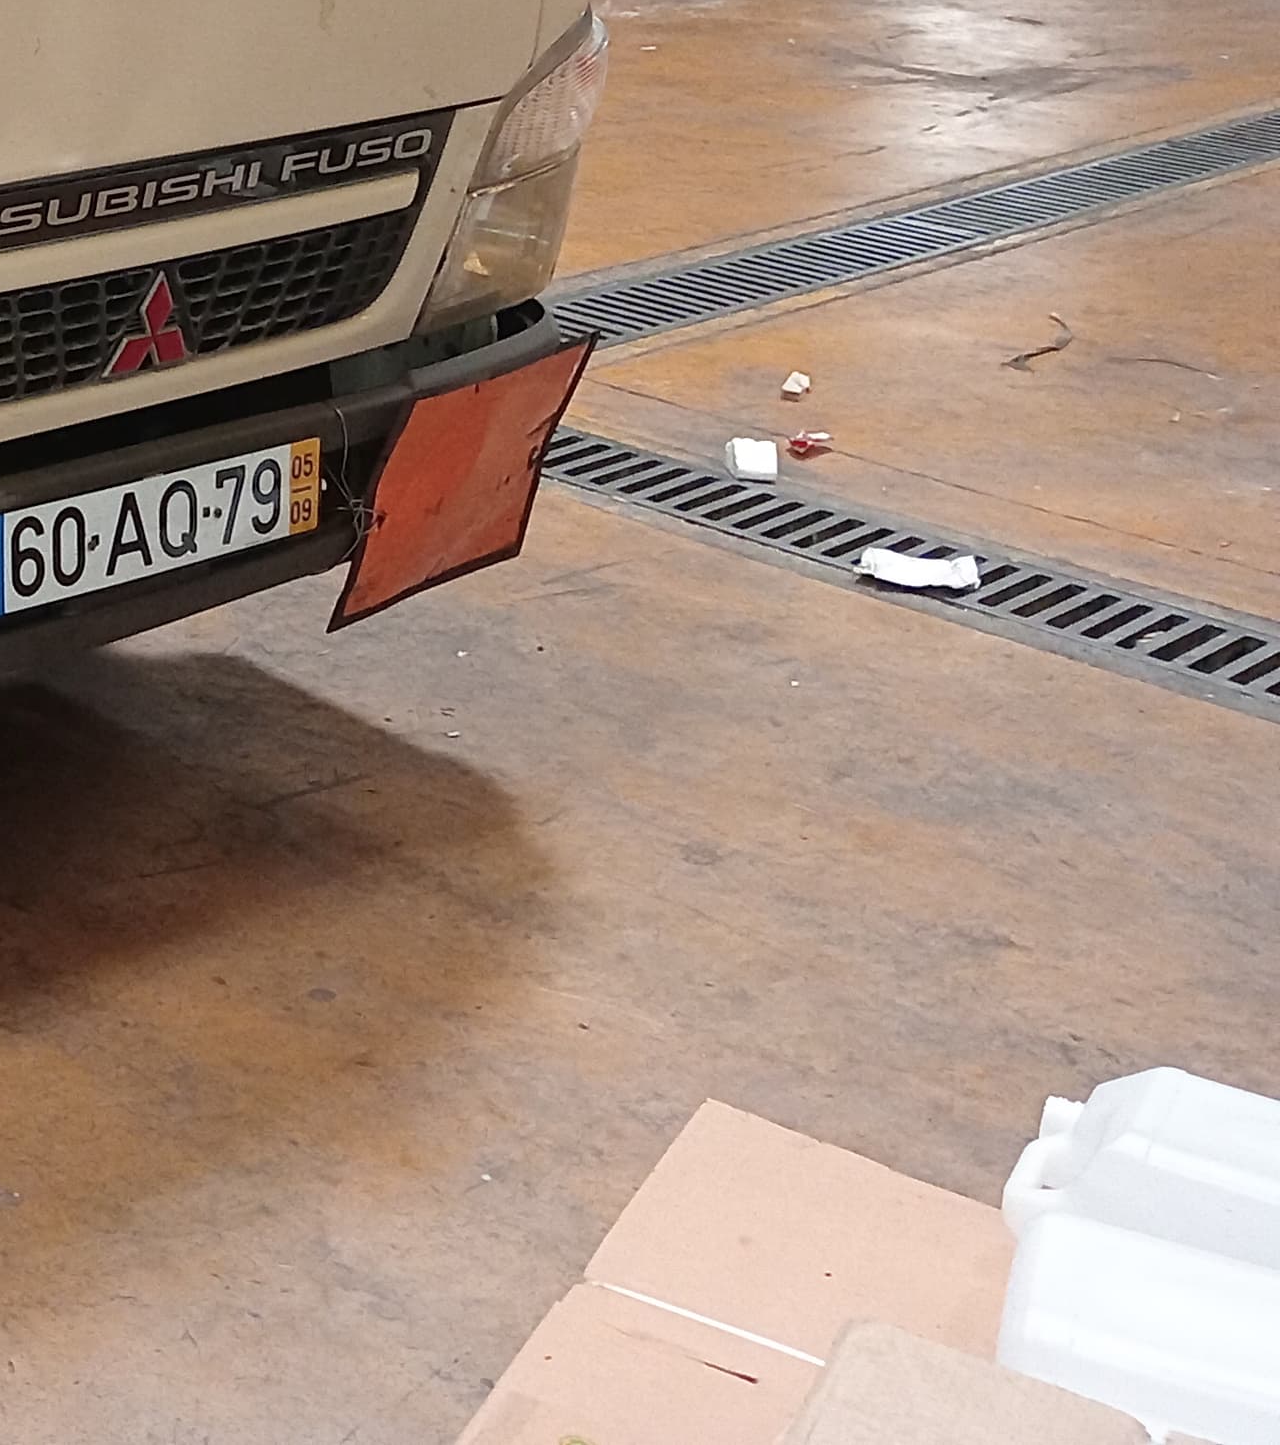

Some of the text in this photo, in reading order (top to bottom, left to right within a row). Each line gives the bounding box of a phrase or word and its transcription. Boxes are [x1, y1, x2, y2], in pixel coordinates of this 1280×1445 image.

[281, 128, 433, 183] FUSO
[291, 455, 314, 480] 05
[289, 499, 313, 525] 09
